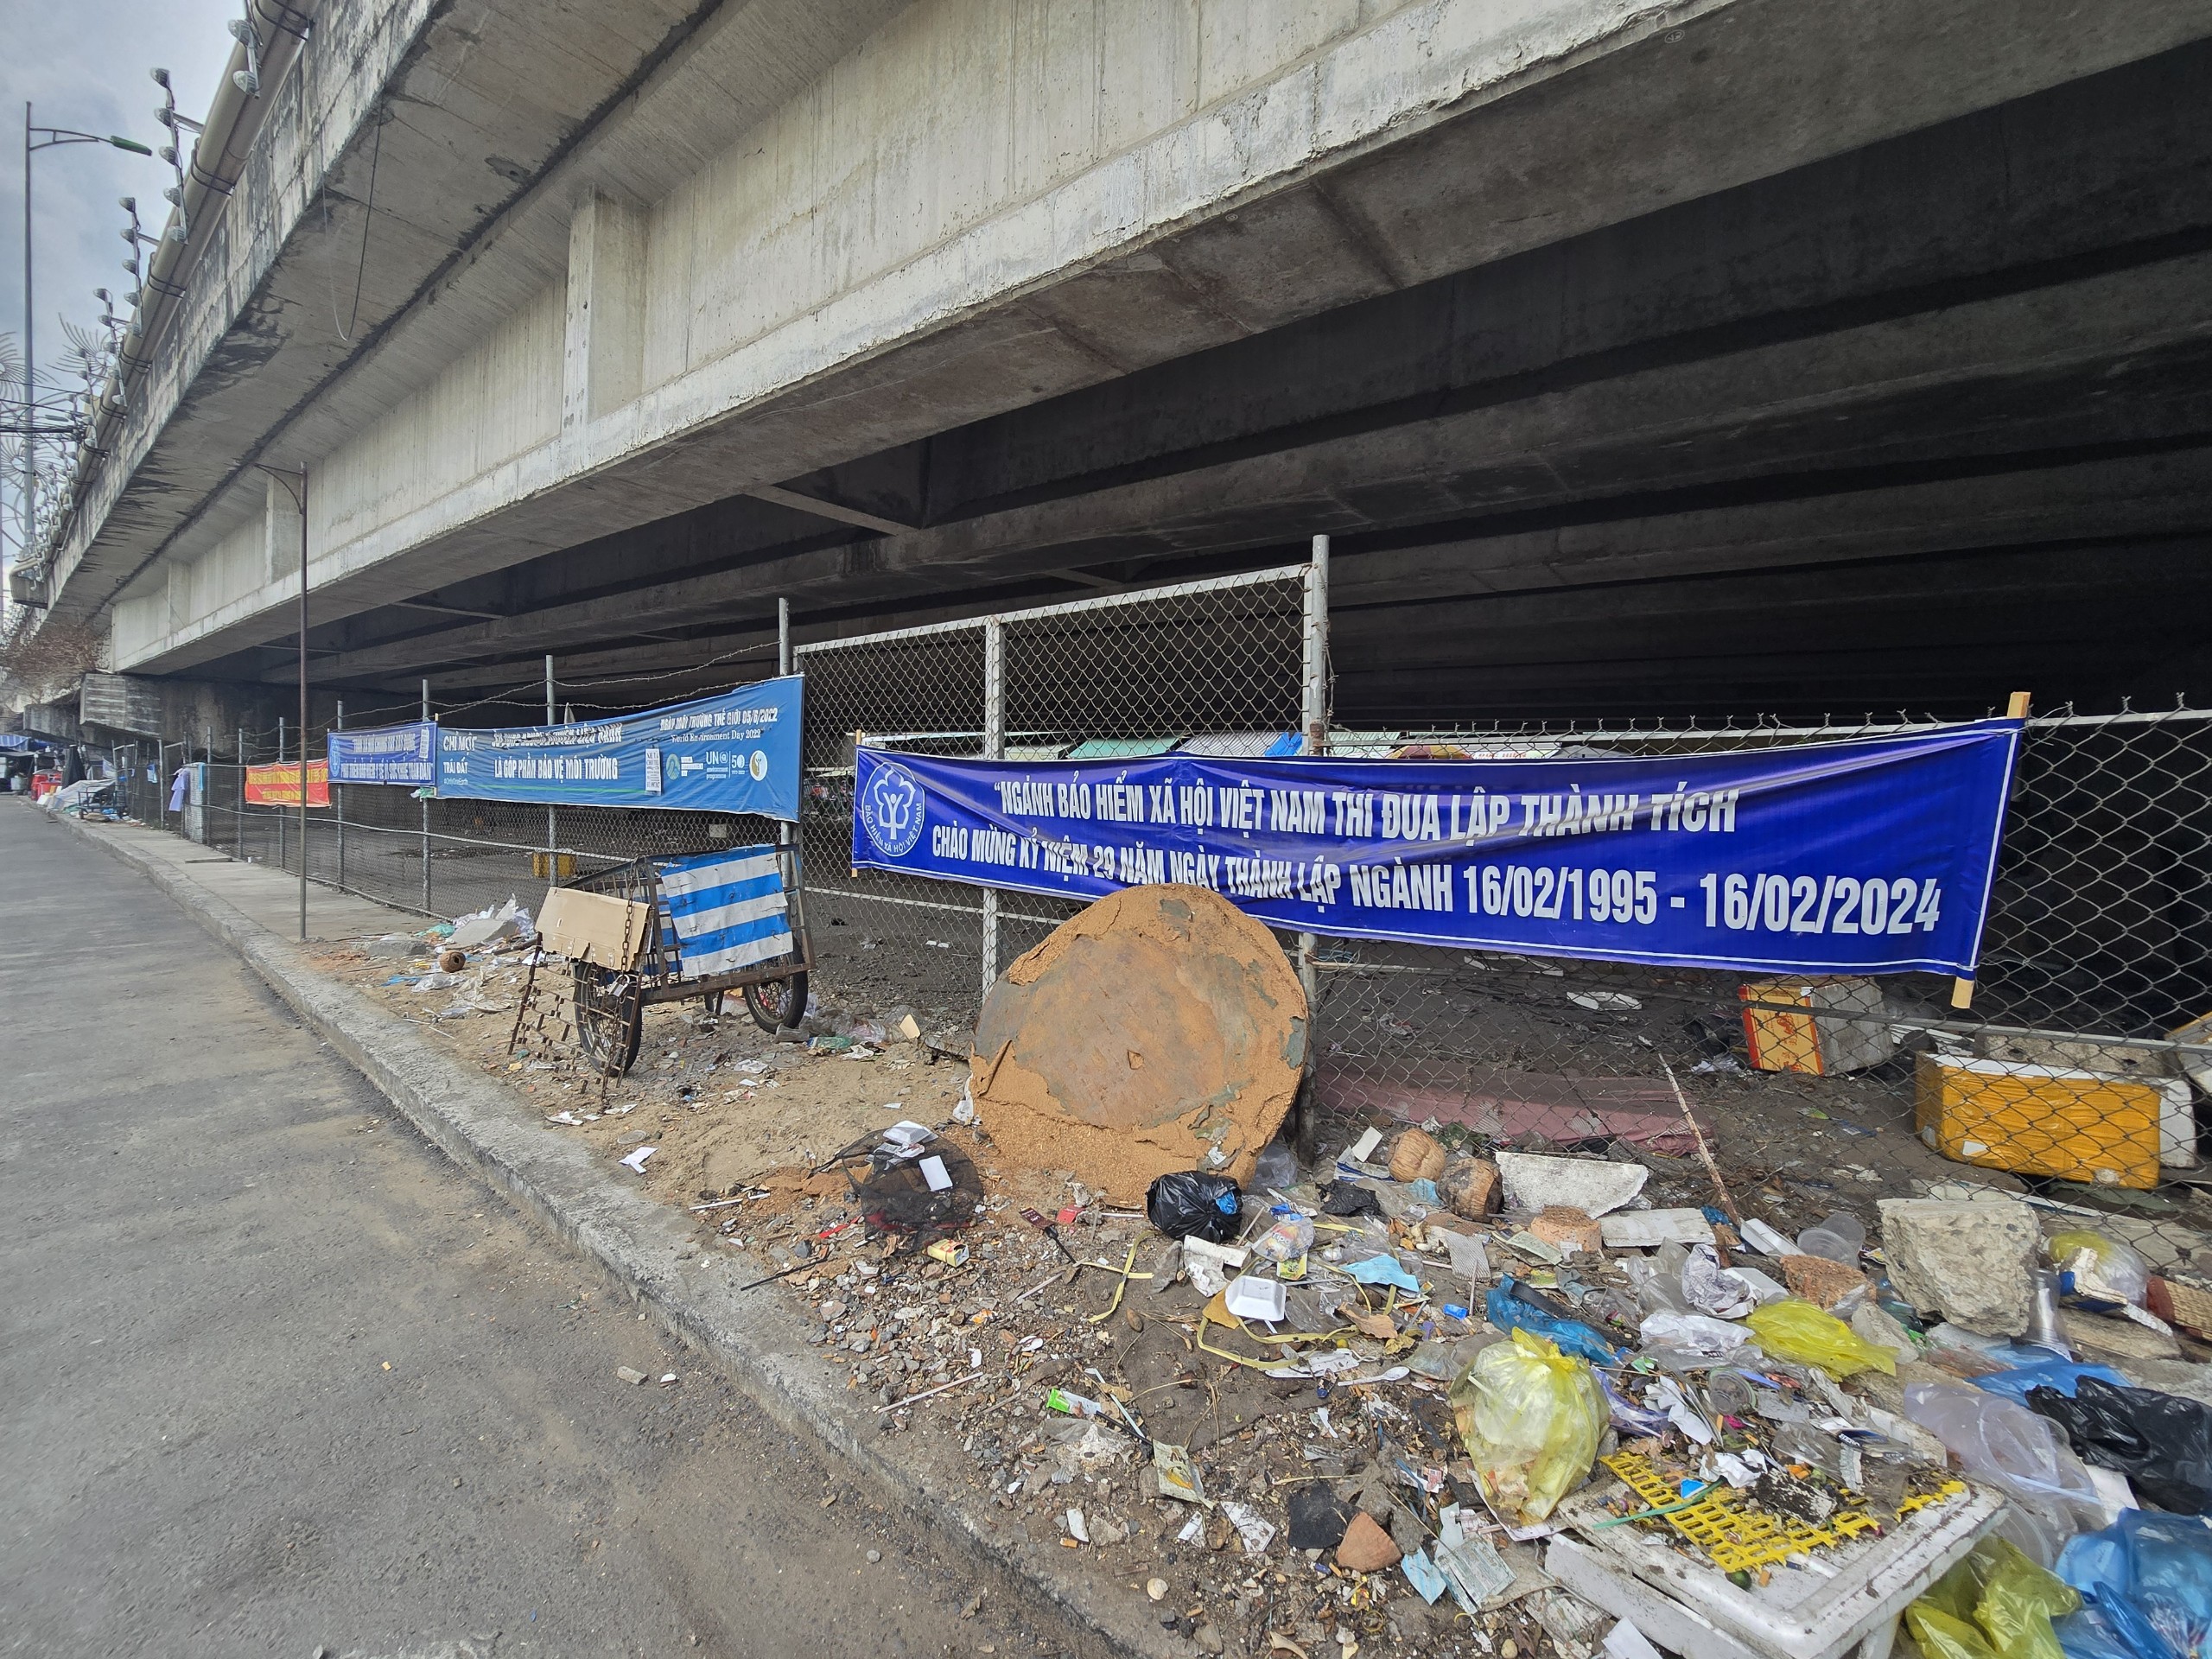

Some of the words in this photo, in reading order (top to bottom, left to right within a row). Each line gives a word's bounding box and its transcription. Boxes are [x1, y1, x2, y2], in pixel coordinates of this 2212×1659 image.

[714, 707, 726, 727] THẾ
[742, 707, 778, 725] 05/6/2022
[443, 731, 459, 751] CHỈ
[458, 732, 477, 755] MỘT
[671, 734, 689, 743] World
[690, 731, 729, 742] Environment
[731, 729, 744, 741] Day
[746, 728, 760, 739] 2022
[443, 758, 455, 773] TRÁI
[456, 756, 467, 774] ĐẤT
[494, 756, 502, 778] LÀ
[504, 756, 517, 778] GÓP
[518, 753, 536, 779] PHẦN
[537, 753, 553, 779] BẢO
[554, 755, 564, 784] VỆ
[565, 756, 582, 779] MÔI
[584, 753, 619, 780] TRƯỜNG
[706, 751, 719, 765] UN
[1058, 771, 1091, 820] BẢO
[1096, 770, 1145, 823] HIỂM
[1149, 778, 1176, 823] XÃ
[1180, 778, 1213, 834] HỘI
[1220, 780, 1265, 838] VIỆT
[1270, 790, 1325, 835] NAM
[1332, 791, 1374, 837] THI
[1382, 793, 1441, 841] ĐUA
[1450, 785, 1510, 847] LẬP
[1518, 784, 1639, 836] THÀNH
[1650, 781, 1740, 832] TÍCH
[865, 804, 874, 823] BẢO
[870, 824, 883, 846] HIỂM
[884, 842, 893, 852] XÃ
[893, 841, 906, 853] HỘI
[906, 825, 918, 846] VIỆT
[932, 820, 968, 861] CHÀO
[971, 823, 1016, 867] MỪNG
[1019, 826, 1039, 869] KỶ
[1041, 835, 1090, 881] NIỆM
[1093, 845, 1115, 880] 29
[1120, 842, 1166, 885] NĂM
[1170, 845, 1221, 892] NGÀY
[1225, 850, 1294, 899] THÀNH
[1296, 855, 1341, 912] LẬP
[1349, 856, 1453, 912] NGÀNH
[1463, 865, 1657, 925] 16/02/1995
[1670, 897, 1685, 909] -
[1700, 873, 1941, 935] 16/02/2024
